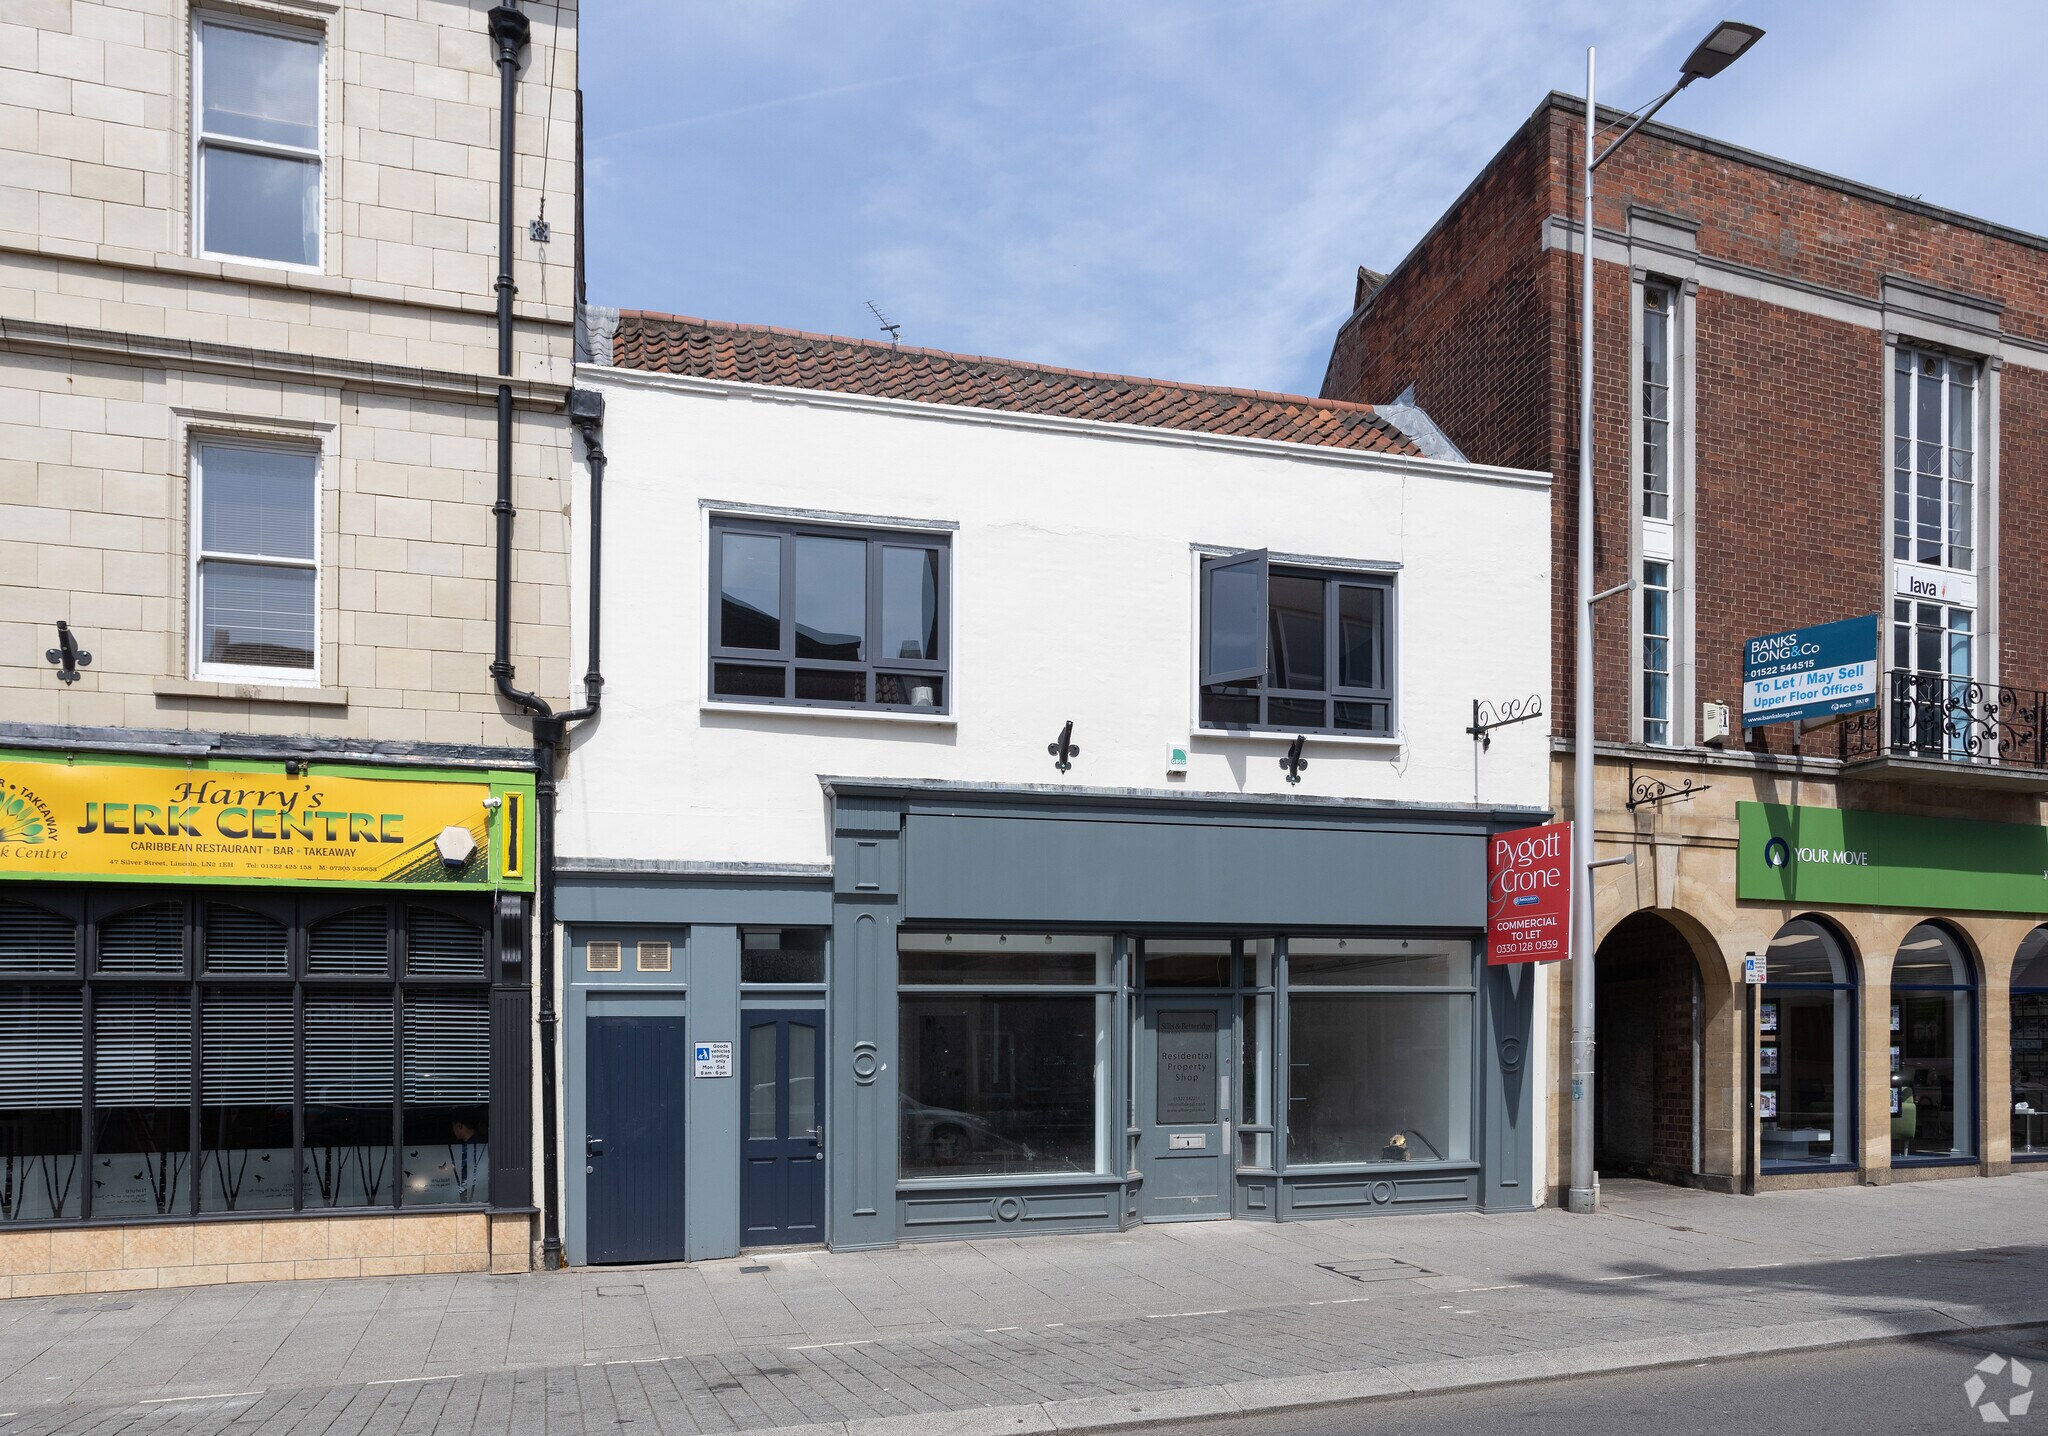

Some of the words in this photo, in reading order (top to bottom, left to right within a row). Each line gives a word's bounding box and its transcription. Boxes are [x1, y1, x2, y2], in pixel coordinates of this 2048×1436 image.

[1909, 575, 1937, 597] lava
[1751, 633, 1797, 653] BANKS
[1750, 665, 1777, 678] 01522
[1780, 659, 1814, 673] 544515
[1755, 680, 1770, 694] To
[1774, 677, 1795, 691] Let
[1806, 670, 1835, 689] May
[1838, 664, 1864, 680] Sell
[1753, 695, 1787, 709] Upper
[1789, 689, 1818, 702] Floor
[1821, 681, 1864, 698] Offices
[1747, 710, 1803, 723] www.bankslong.com
[170, 780, 324, 816] Harry's
[19, 786, 59, 842] TAKEAWAY
[77, 802, 202, 837] JERK
[216, 806, 404, 844] CENTRE
[15, 846, 68, 860] Centre
[130, 841, 193, 853] CARIBBEAN
[195, 843, 263, 854] RESTAURANT
[273, 846, 294, 856] BAR
[304, 847, 357, 857] TAKEAWAY
[1496, 832, 1560, 868] Pygott
[1794, 847, 1829, 864] YOUR
[1832, 850, 1868, 866] MOVE
[1501, 867, 1560, 893] Crone
[1497, 916, 1558, 931] COMMERCIAL
[1511, 931, 1524, 941] TO
[1526, 930, 1541, 940] LET
[1496, 943, 1517, 954] 0330
[1518, 941, 1533, 951] 128
[1535, 939, 1558, 950] 0939
[1162, 1052, 1212, 1060] Residential
[1167, 1063, 1207, 1072] Property
[1175, 1073, 1199, 1082] Shop
